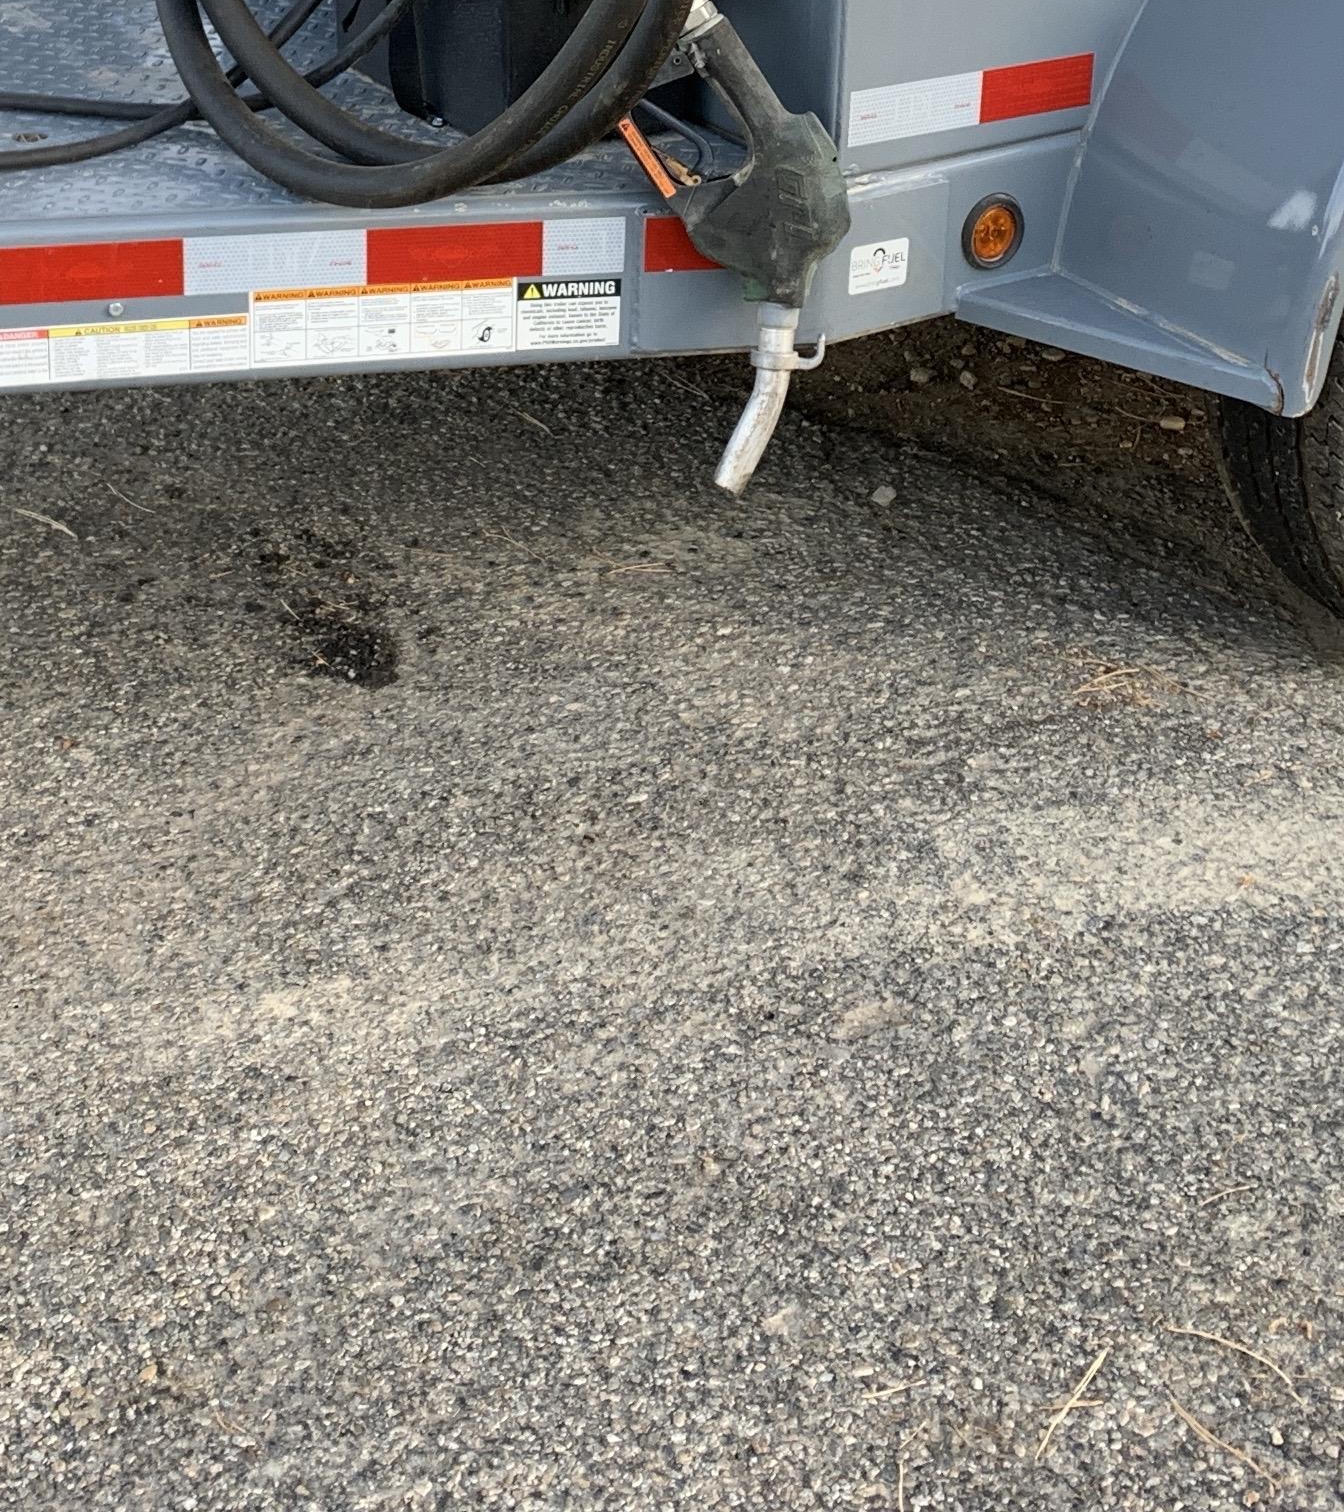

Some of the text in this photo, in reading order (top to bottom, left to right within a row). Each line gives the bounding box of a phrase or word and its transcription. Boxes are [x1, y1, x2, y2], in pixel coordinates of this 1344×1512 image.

[419, 283, 461, 292] WARNING
[471, 279, 512, 289] WARNING
[541, 280, 616, 298] WARNING
[314, 288, 356, 298] WARNING
[367, 286, 407, 295] WARNING
[263, 292, 304, 300] WARNING
[203, 317, 242, 327] WARNING
[83, 325, 121, 336] CAUTION
